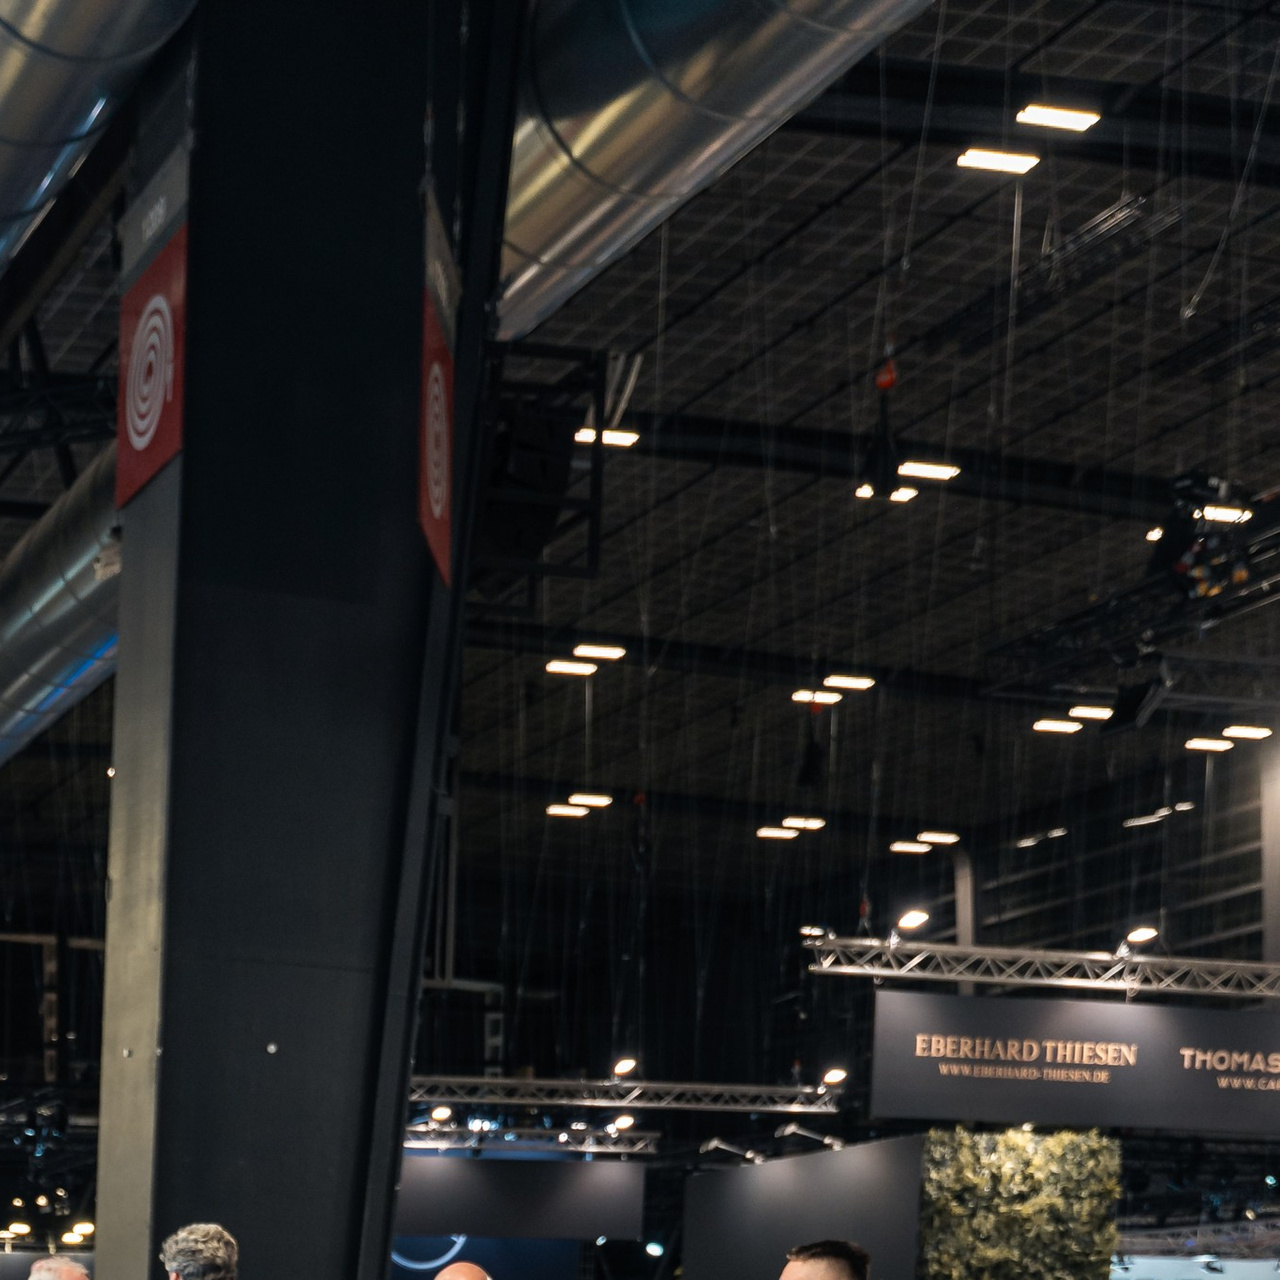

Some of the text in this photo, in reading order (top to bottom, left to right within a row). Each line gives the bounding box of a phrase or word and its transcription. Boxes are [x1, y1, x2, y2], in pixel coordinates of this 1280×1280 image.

[915, 1033, 1138, 1066] EBERHARD THIESEN
[1179, 1046, 1280, 1073] THOMAS
